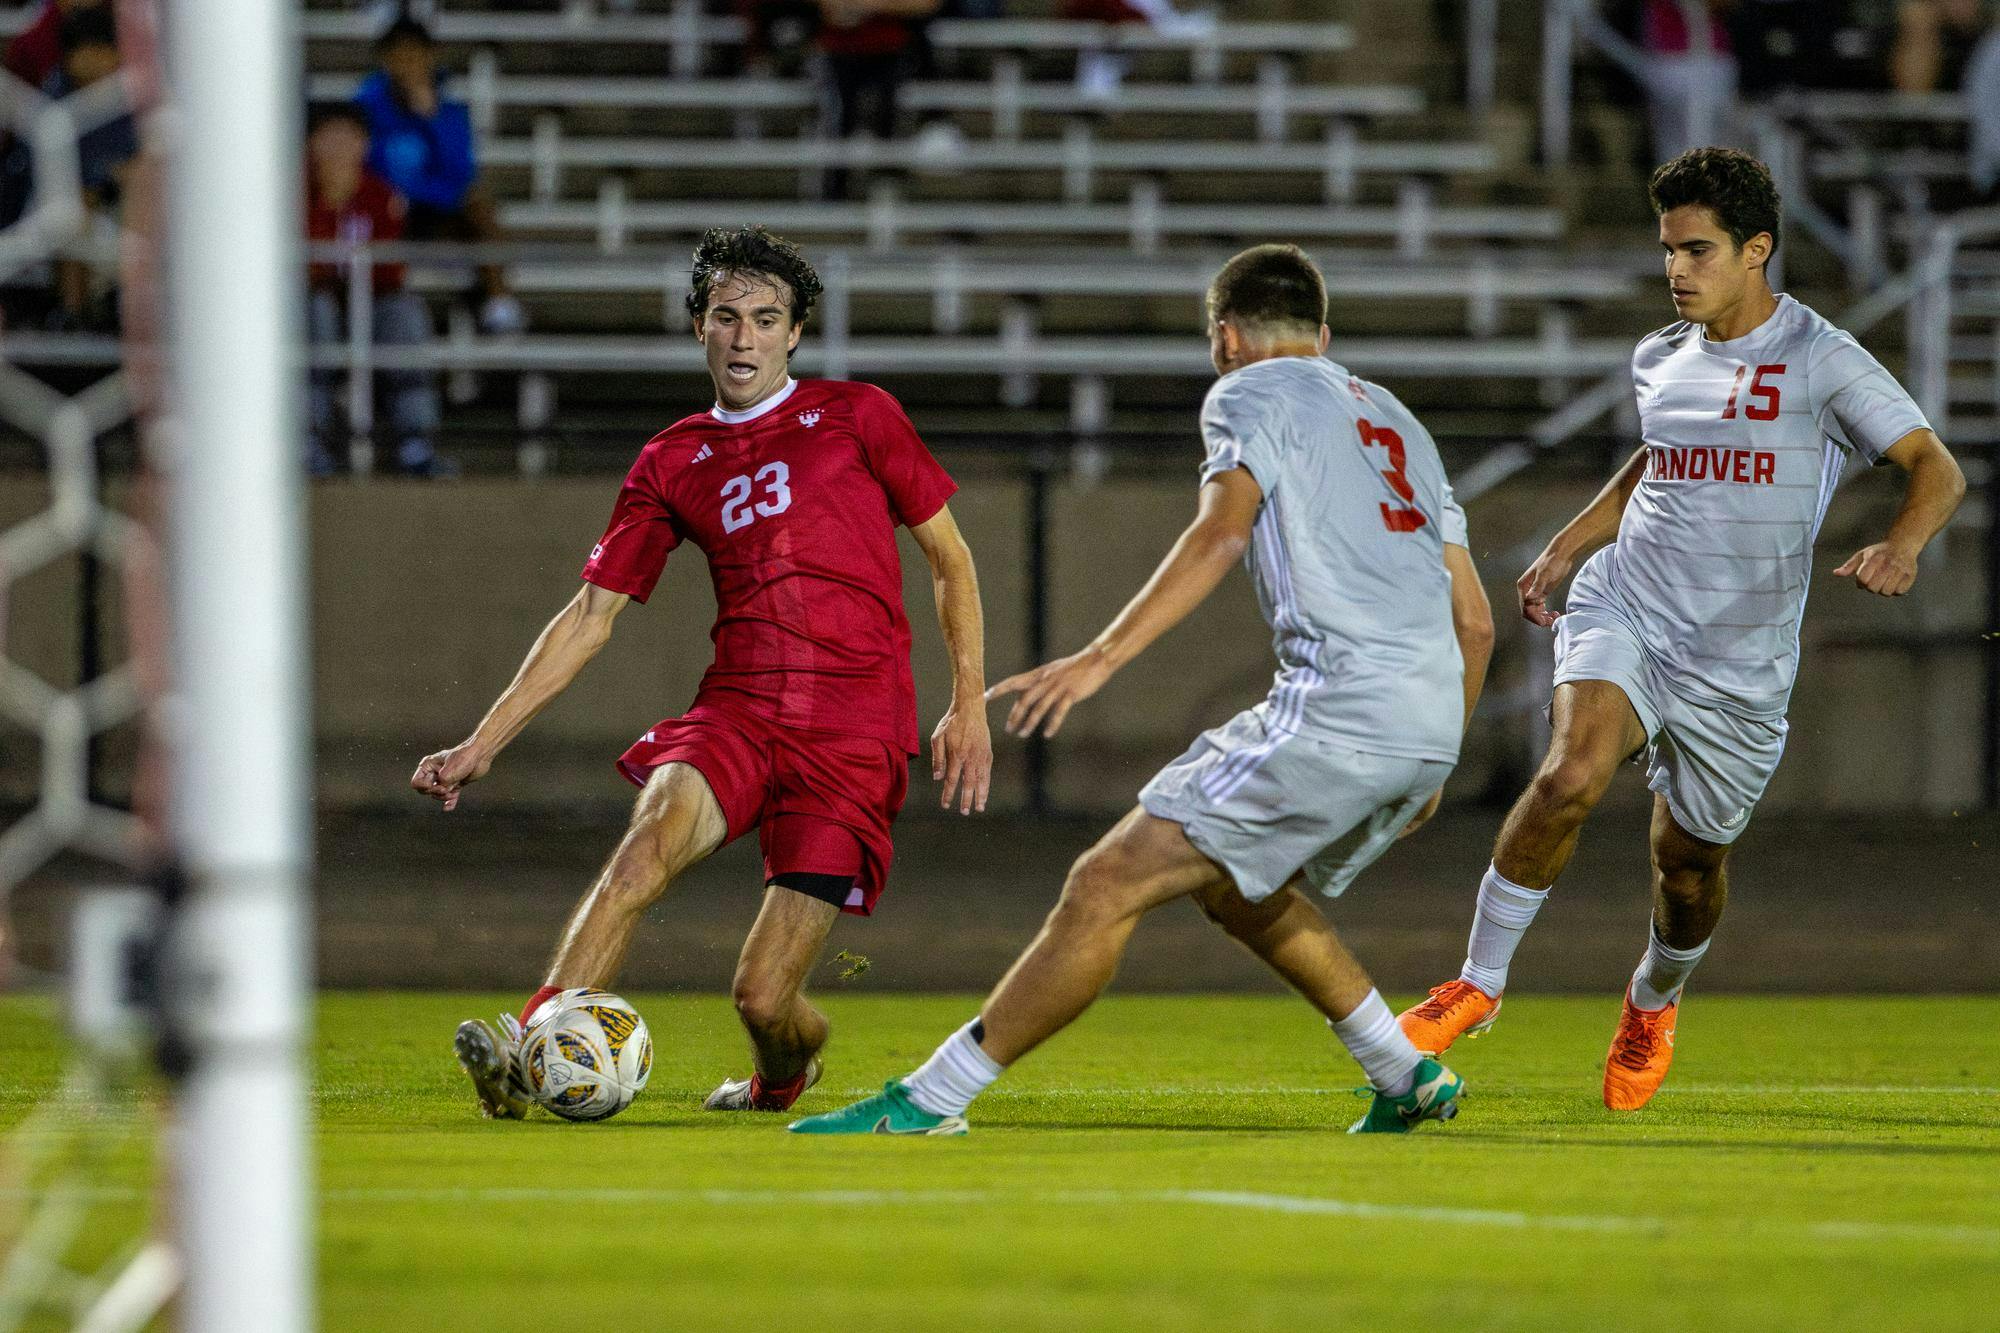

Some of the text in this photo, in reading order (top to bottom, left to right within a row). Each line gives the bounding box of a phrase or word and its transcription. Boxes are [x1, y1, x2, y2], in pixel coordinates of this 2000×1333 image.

[1721, 363, 1787, 421] 15
[720, 460, 792, 535] 23
[1356, 417, 1427, 533] 3
